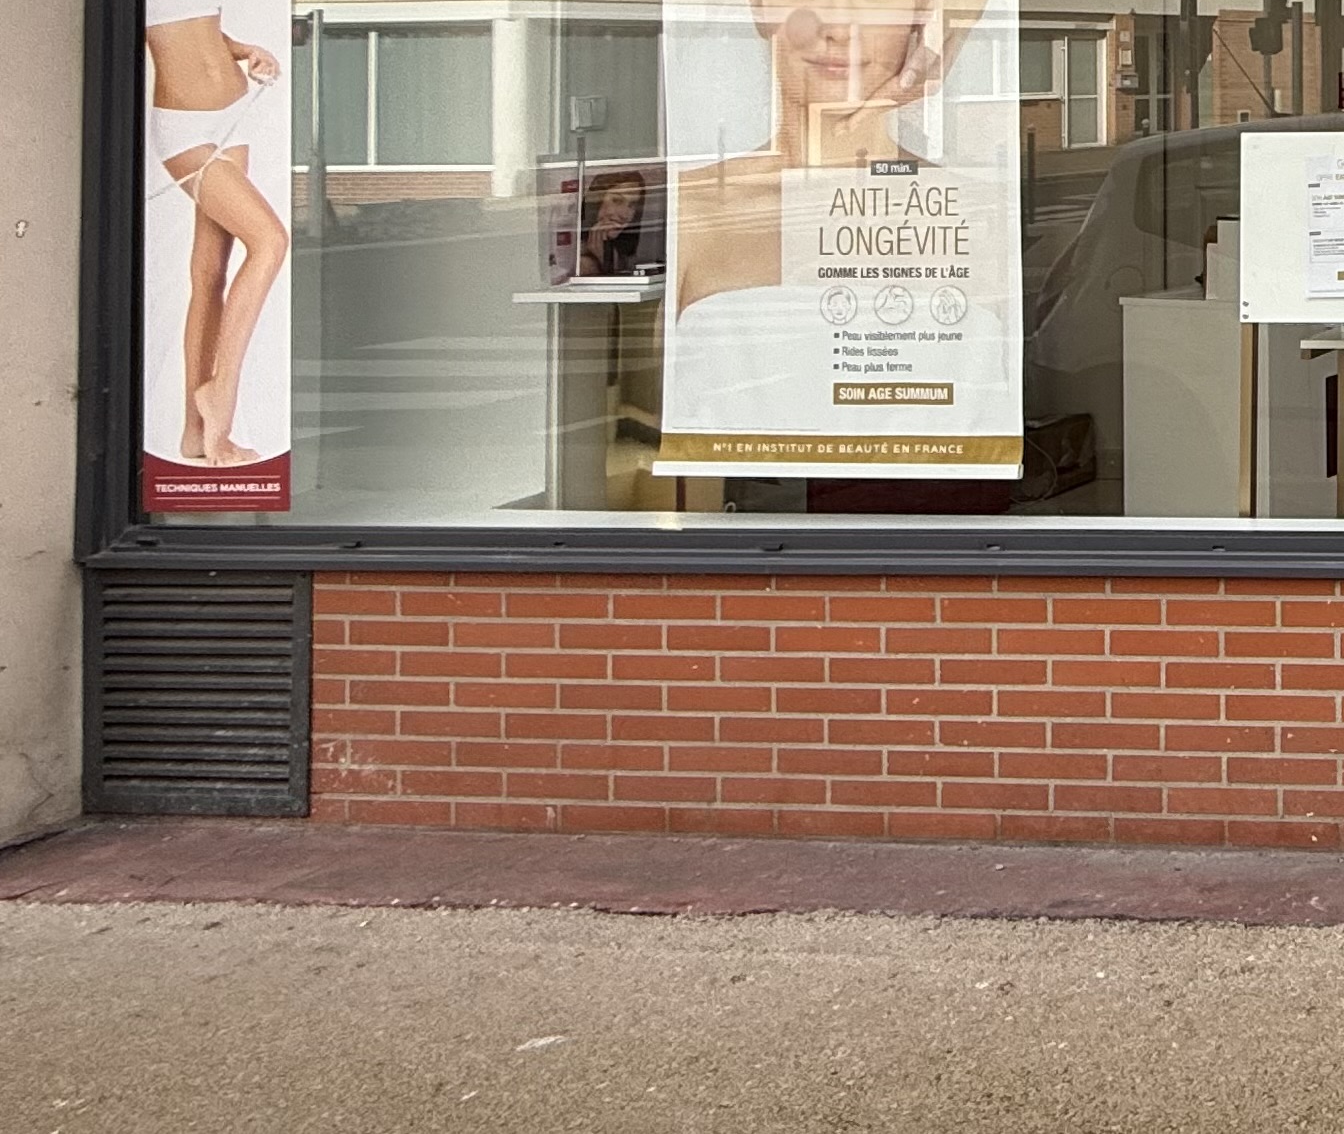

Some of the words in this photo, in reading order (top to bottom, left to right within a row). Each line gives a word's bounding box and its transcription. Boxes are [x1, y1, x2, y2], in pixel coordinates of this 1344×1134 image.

[875, 163, 888, 174] 50
[890, 163, 913, 174] min.
[829, 180, 959, 216] ANTI-ÂGE
[818, 219, 970, 256] LONGÉVITÉ
[818, 267, 859, 279] GOMME
[860, 267, 880, 279] LES
[882, 267, 922, 278] SIGNES
[925, 267, 938, 278] DE
[940, 264, 970, 278] L'ÂGE
[842, 331, 862, 341] Peau
[864, 330, 916, 341] visiblement
[918, 330, 936, 343] plus
[938, 331, 963, 343] jeune
[842, 346, 865, 357] Rides
[842, 361, 862, 372] Peau
[864, 362, 884, 374] plus
[886, 361, 913, 372] ferme
[839, 387, 866, 400] SOIN
[867, 387, 893, 400] AGE
[895, 387, 949, 400] SUMMUM
[713, 442, 732, 452] N°1
[737, 443, 753, 453] EN
[757, 443, 813, 454] INSTITUT
[817, 444, 833, 454] DE
[839, 441, 888, 454] BEAUTÉ
[893, 444, 911, 454] EN
[915, 444, 964, 454] FRANCE
[154, 483, 218, 493] TECHNIQUES
[220, 482, 281, 493] MANUELLES
